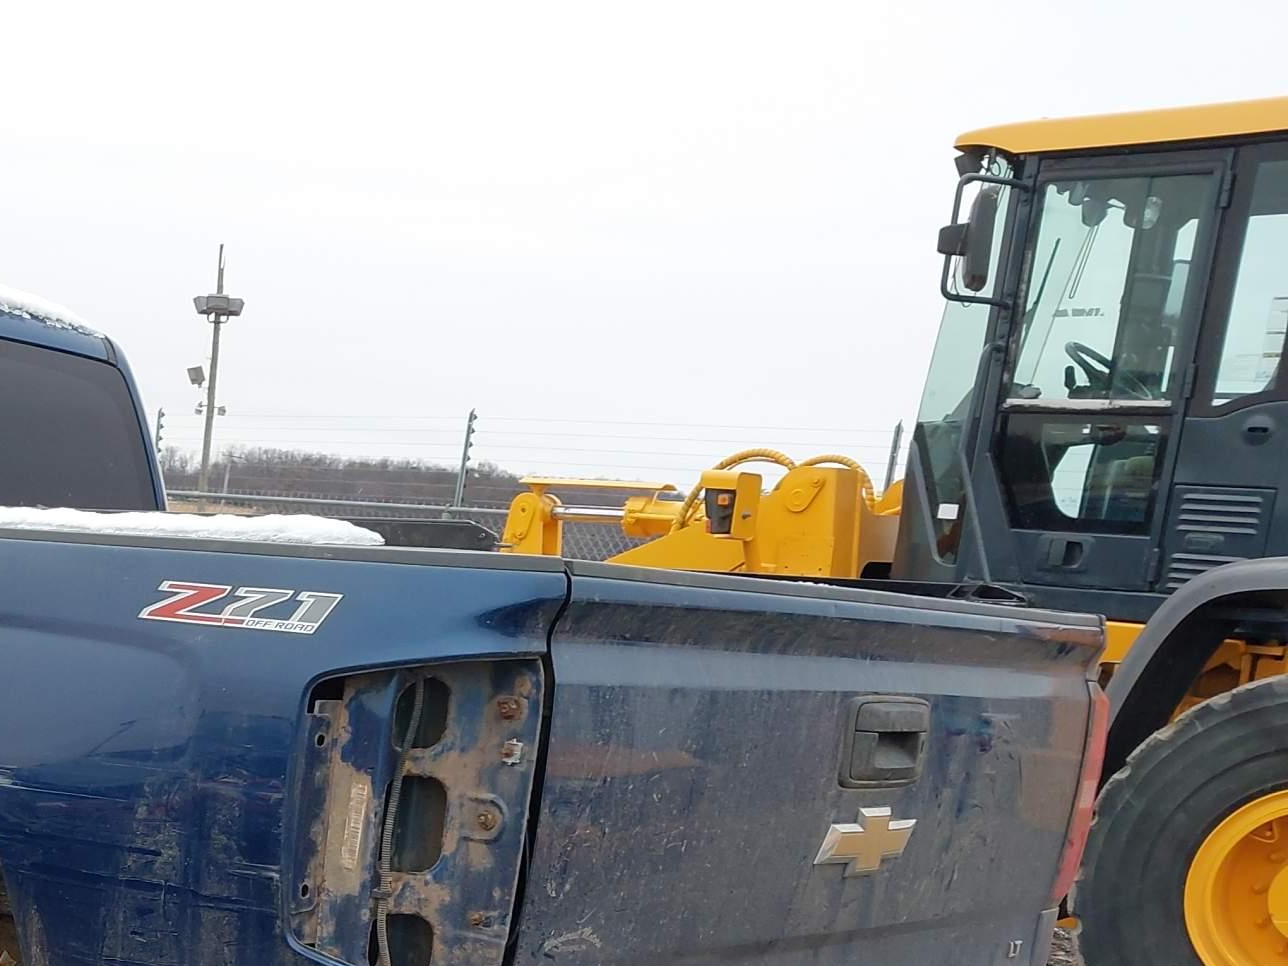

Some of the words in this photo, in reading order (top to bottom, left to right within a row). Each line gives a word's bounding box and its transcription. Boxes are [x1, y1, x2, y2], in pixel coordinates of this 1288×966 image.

[138, 580, 344, 628] Z71
[245, 618, 273, 629] OFF
[274, 621, 315, 632] ROAD
[1008, 940, 1023, 958] LT
